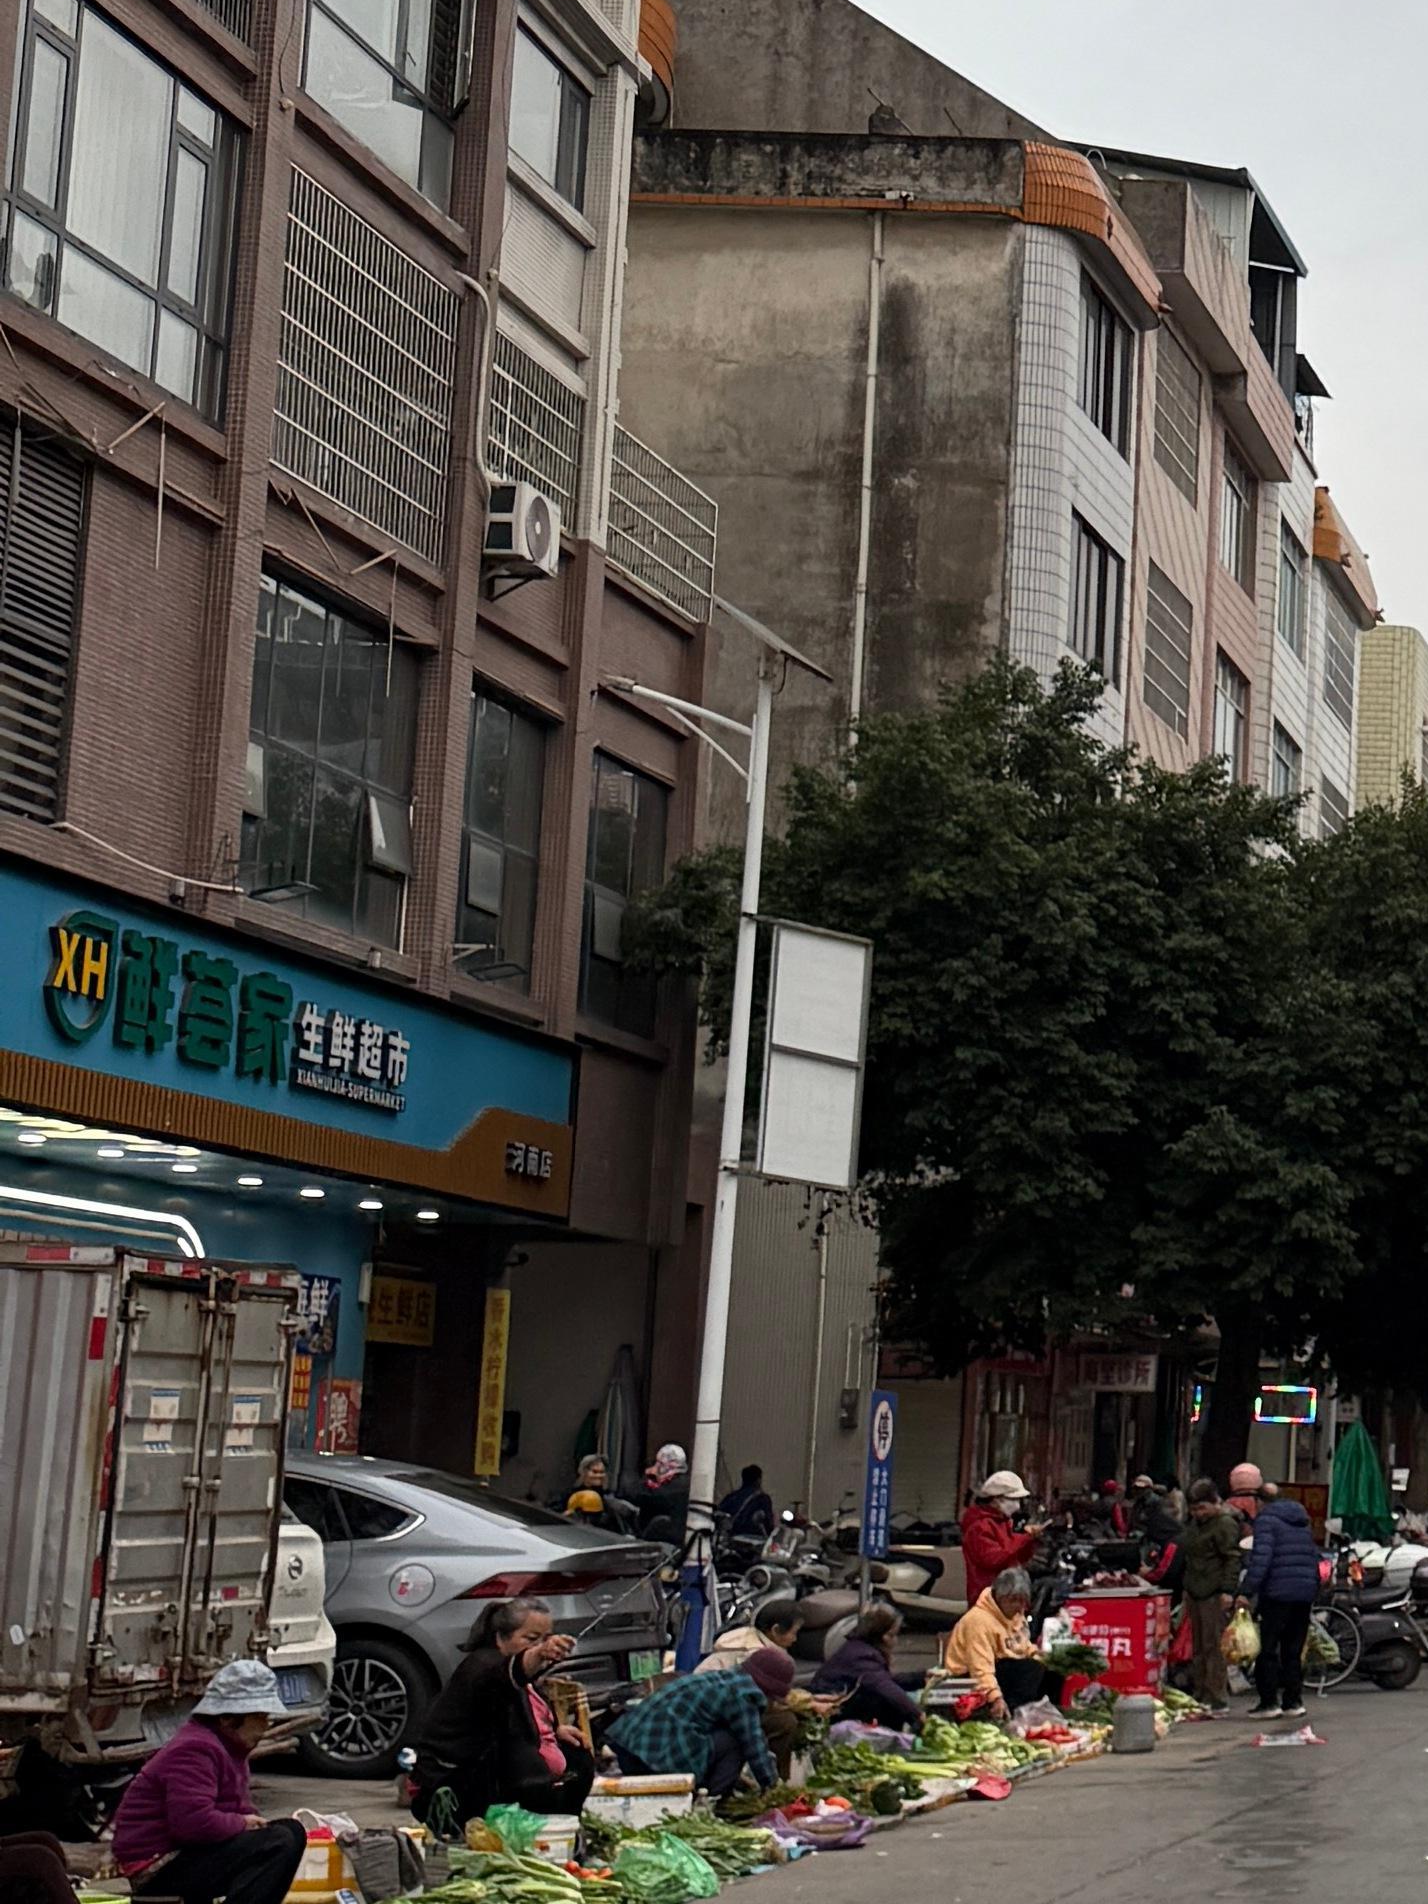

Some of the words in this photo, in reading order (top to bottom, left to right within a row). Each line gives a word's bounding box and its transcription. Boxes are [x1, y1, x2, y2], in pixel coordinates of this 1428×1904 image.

[53, 927, 108, 1000] XH
[115, 929, 293, 1084] 鲜荟家
[298, 1002, 410, 1087] 生鲜超市
